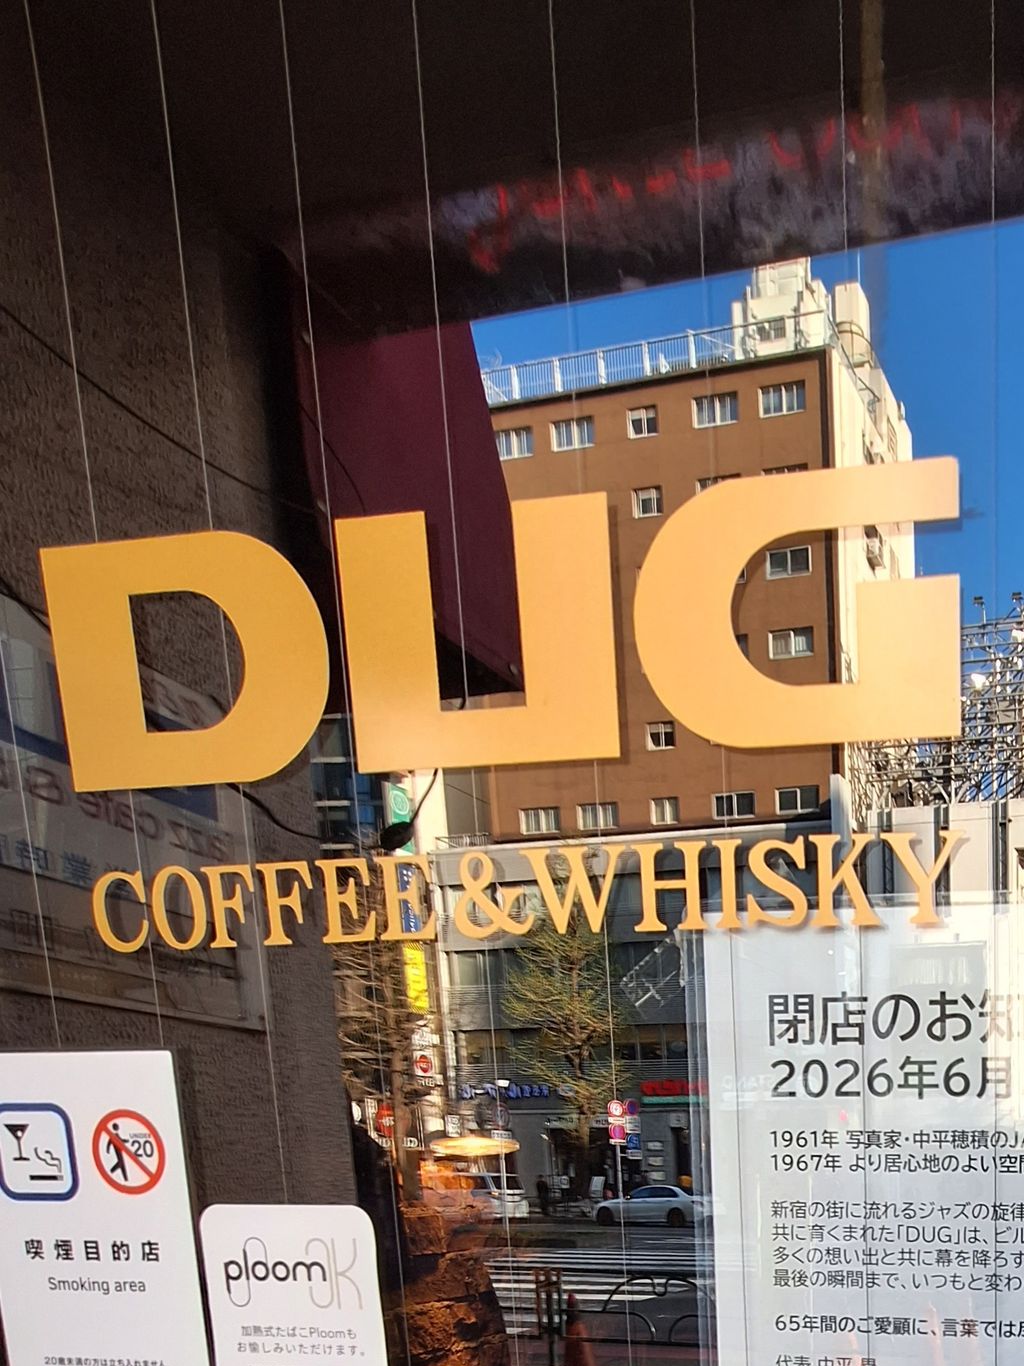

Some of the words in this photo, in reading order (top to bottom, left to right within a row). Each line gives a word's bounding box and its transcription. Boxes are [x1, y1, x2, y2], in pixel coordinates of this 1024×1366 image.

[40, 457, 961, 793] DUG
[131, 1140, 154, 1158] 20
[25, 1239, 161, 1263] 喫煙目的店
[48, 1276, 110, 1295] Smoking
[115, 1279, 146, 1293] area
